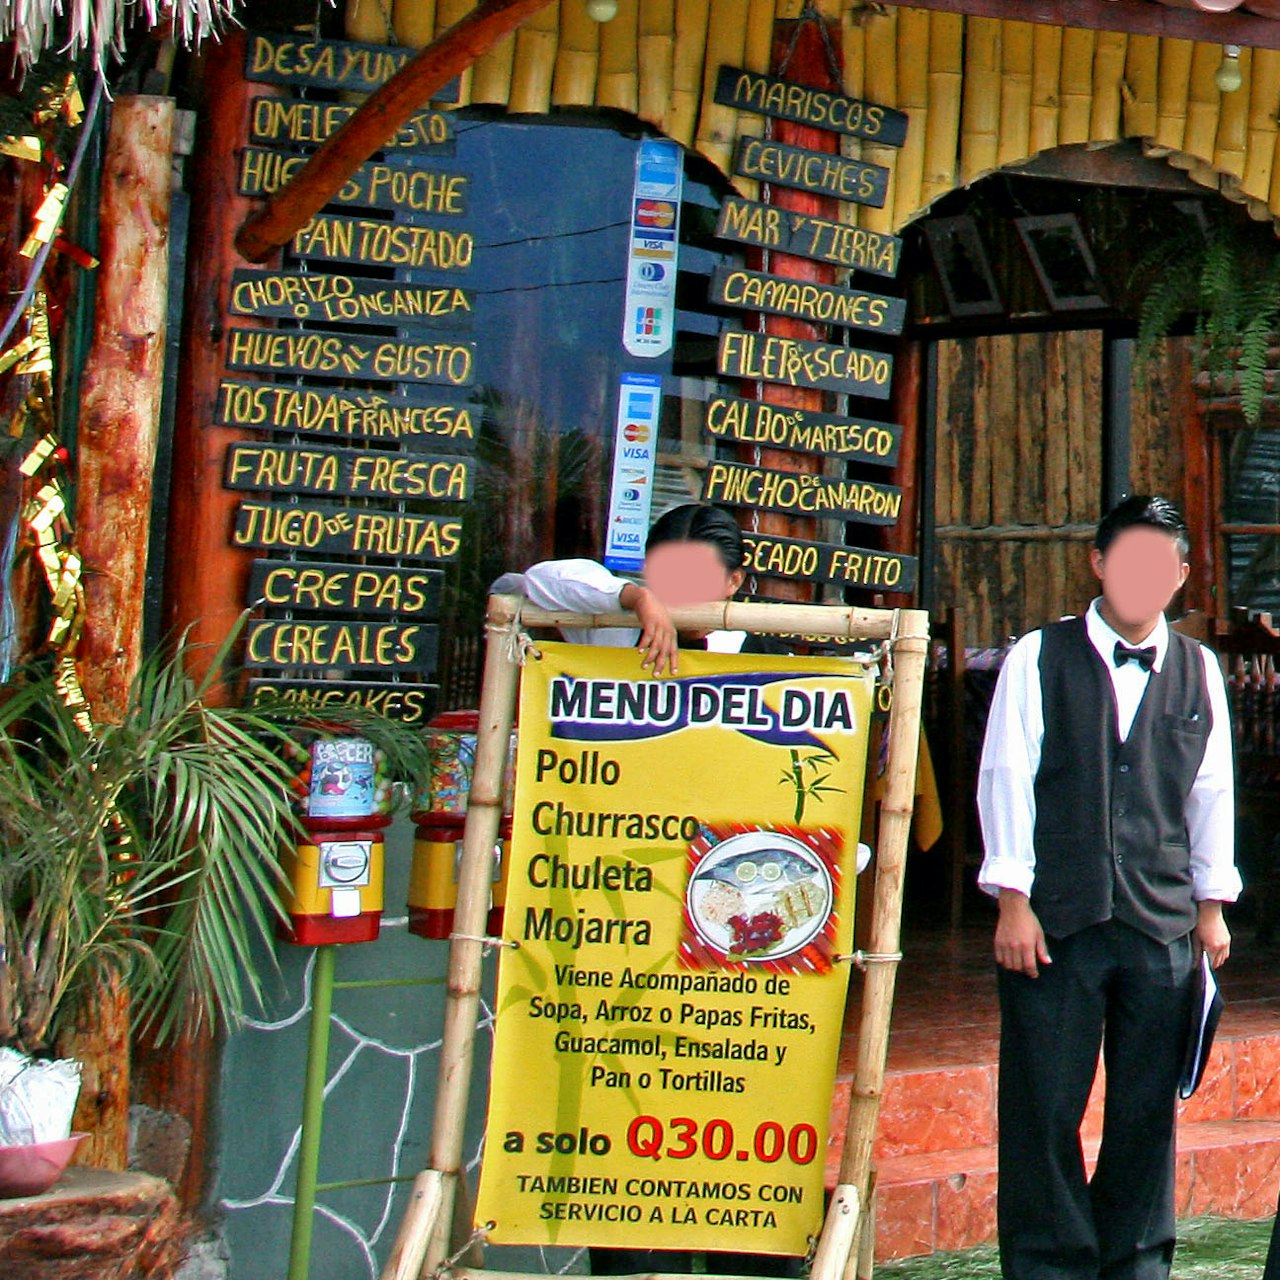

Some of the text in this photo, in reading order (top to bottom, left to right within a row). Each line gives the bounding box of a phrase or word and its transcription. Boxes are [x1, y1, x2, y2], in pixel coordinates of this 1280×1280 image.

[734, 74, 885, 135] MARISCOS
[369, 166, 467, 213] POCHE
[743, 141, 879, 197] CEVICHES
[360, 221, 473, 268] TOSTADO
[721, 201, 896, 272] MAR TIERRA
[233, 275, 471, 321] CHORIZO LONGANIZA
[724, 272, 888, 327] CAMARONES
[230, 331, 342, 370] HUEVOS
[373, 342, 472, 384] GUSTO
[721, 332, 889, 386] FILET PESCADO
[221, 383, 474, 439] TOSTADA FRANCESA
[707, 399, 788, 443] CALDO
[789, 424, 893, 457] MARISCO
[230, 448, 466, 500] FRUTA FRESCA
[623, 448, 649, 460] VISA
[707, 465, 798, 508] PINCHO
[799, 483, 901, 518] CAMARON
[234, 504, 462, 558] JUGO DE FRUTAS
[616, 533, 640, 544] VISA
[264, 568, 429, 612] CREPAS
[829, 551, 901, 586] FRITO
[249, 622, 420, 665] CEREALES
[551, 679, 853, 730] MENU DEL DIA
[536, 748, 620, 786] Pollo
[532, 800, 698, 841] Churrasco
[528, 853, 652, 892] Chuleta
[524, 906, 651, 948] Mojarra
[554, 964, 790, 995] Viene Acompañado de
[529, 996, 815, 1034] Sopa, Arroz o Papas Fritas,
[554, 1031, 787, 1065] Guacamol, Ensalada y
[591, 1066, 746, 1094] Pan o Tortillas
[503, 1115, 818, 1165] a solo Q30.00
[516, 1175, 803, 1204] TAMBIEN CONTAMOS CON
[539, 1202, 777, 1229] SERVICIO A LA CARTA
